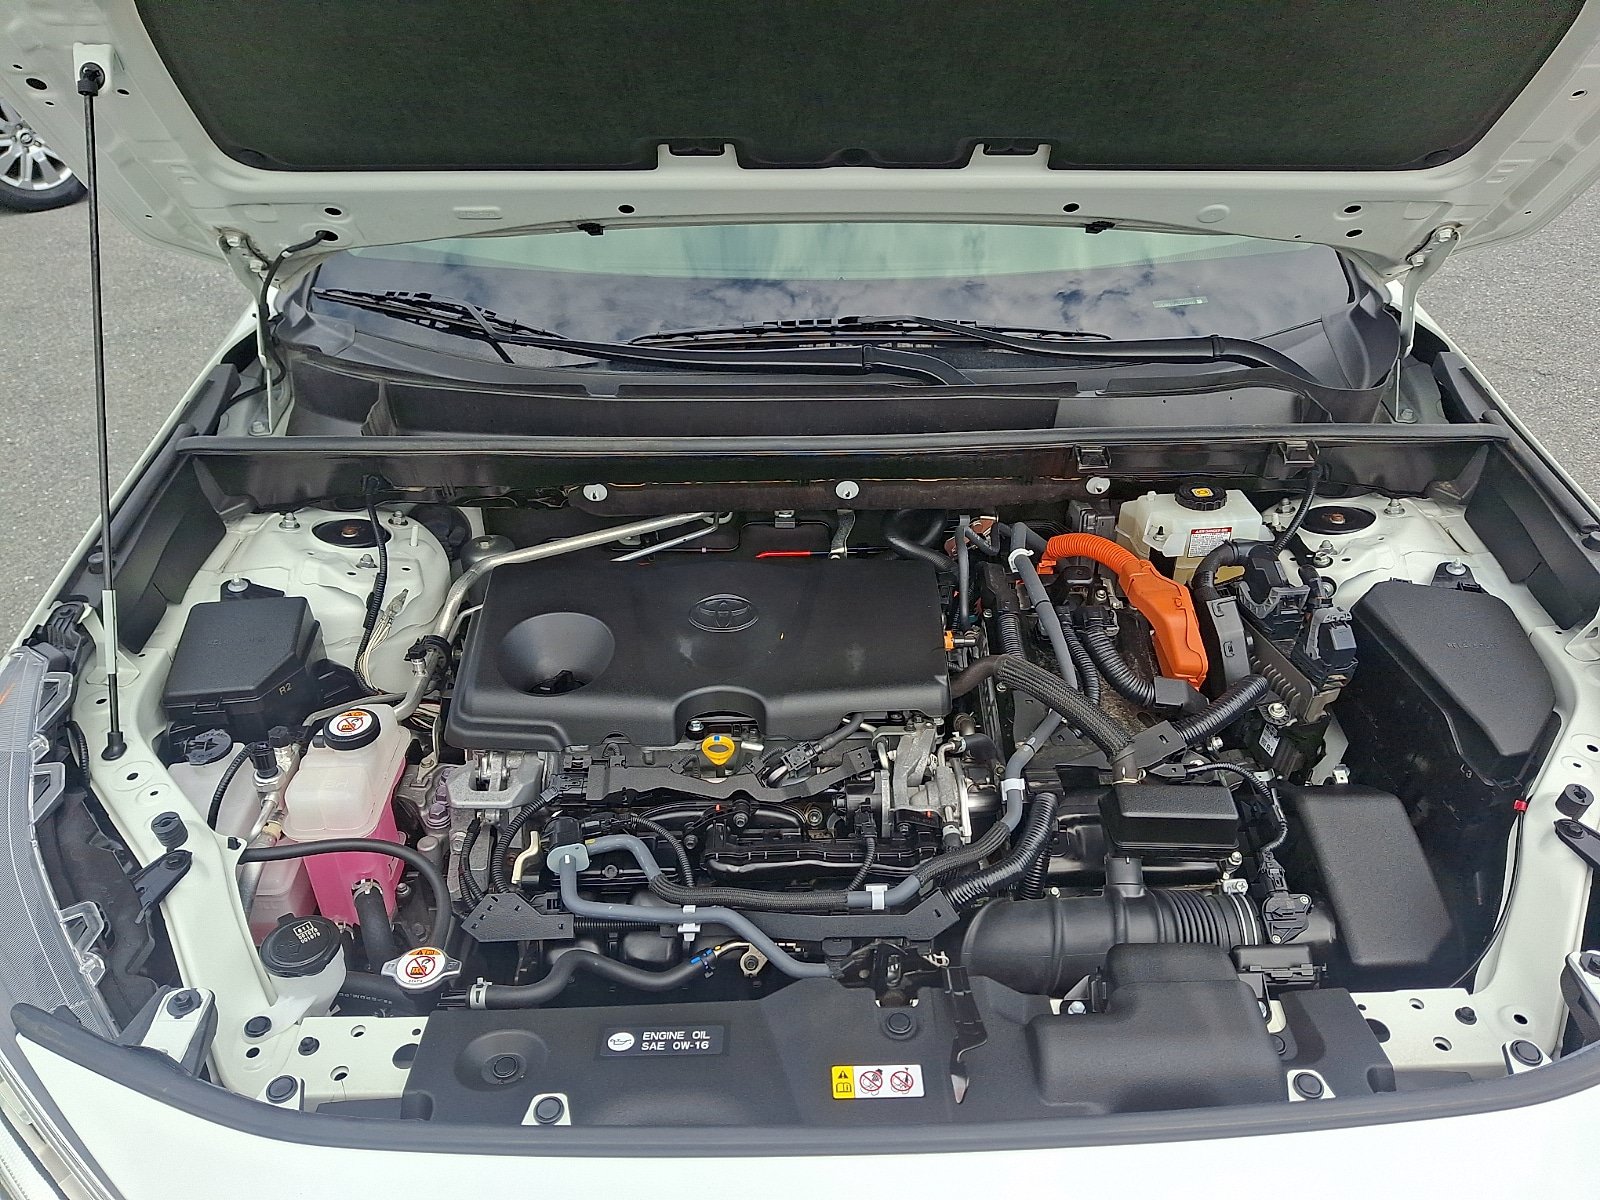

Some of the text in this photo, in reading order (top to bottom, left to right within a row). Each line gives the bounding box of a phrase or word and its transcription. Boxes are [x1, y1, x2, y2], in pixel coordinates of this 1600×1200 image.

[279, 682, 292, 695] R2
[642, 1030, 711, 1040] ENGINE OIL
[641, 1041, 665, 1051] SAE
